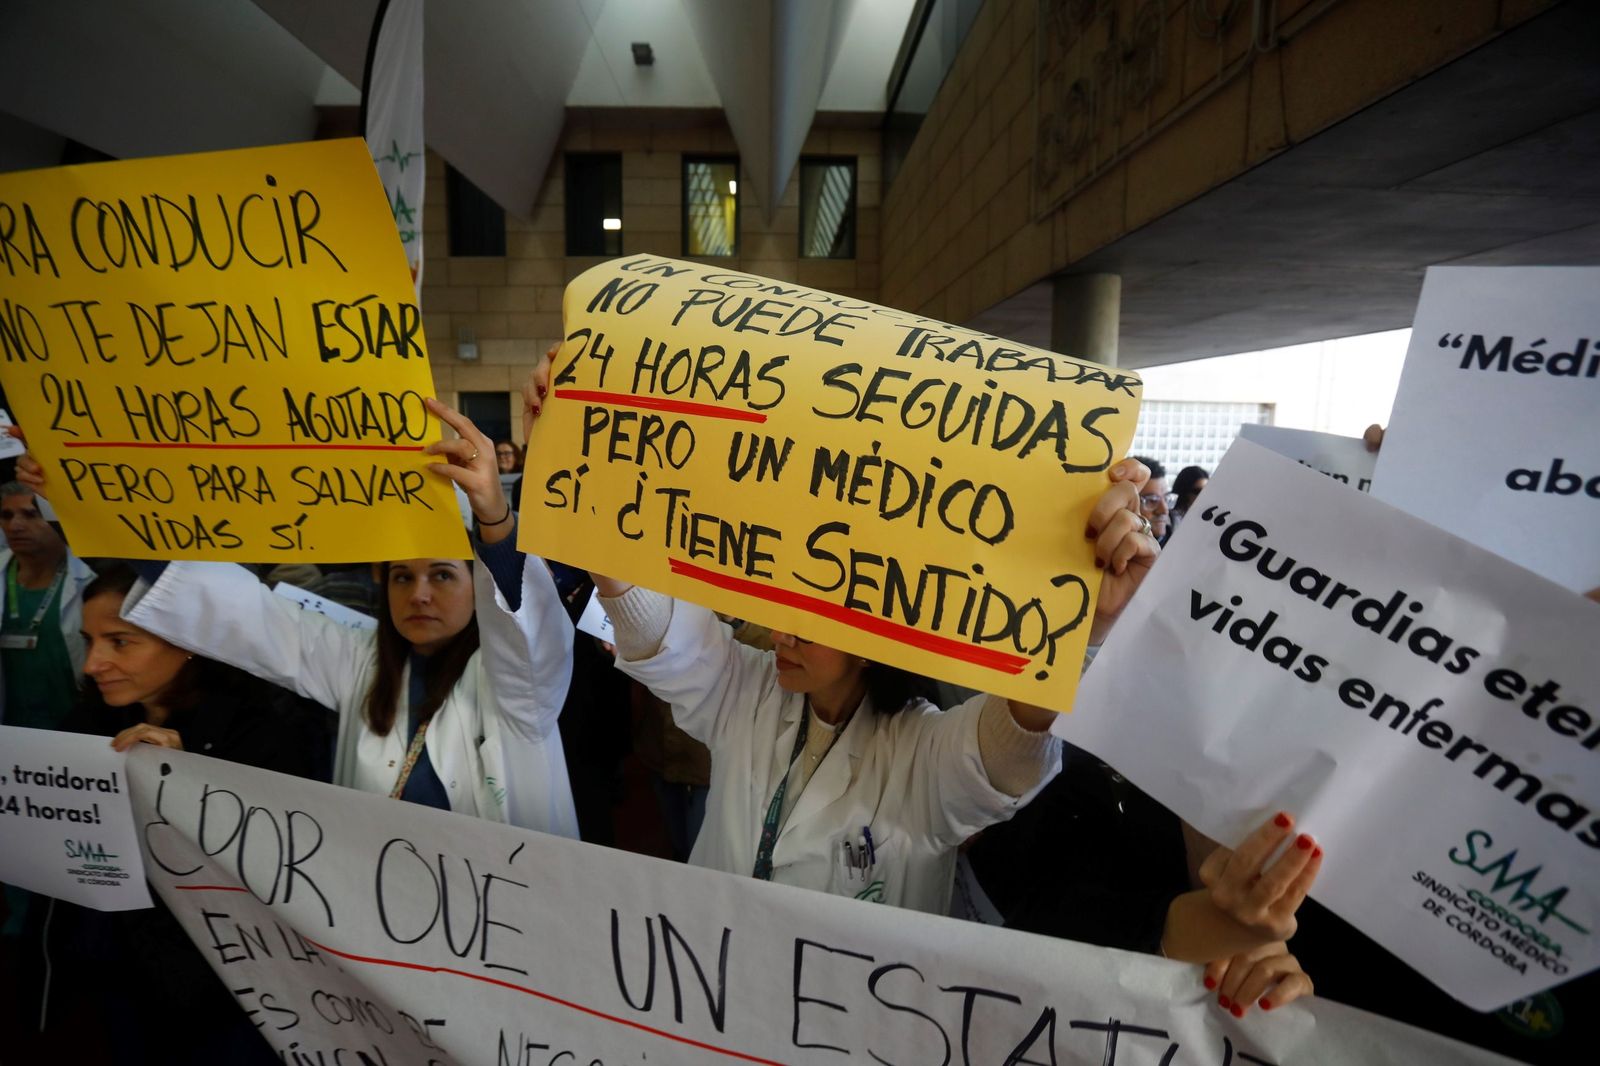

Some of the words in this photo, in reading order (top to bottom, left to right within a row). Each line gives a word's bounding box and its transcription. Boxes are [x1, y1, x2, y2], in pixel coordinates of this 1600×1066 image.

[0, 202, 60, 278] RA
[620, 258, 695, 278] UN
[0, 298, 49, 363] NO
[48, 301, 118, 364] TE
[128, 296, 289, 367] DEJAN
[312, 294, 424, 363] ESTAR
[586, 277, 660, 316] NO
[671, 288, 869, 346] PUEDE
[895, 324, 1144, 398] TRABAJAR
[554, 327, 615, 389] 24
[631, 337, 790, 410] HORAS
[40, 373, 103, 439] 24
[115, 385, 261, 443] HORAS
[282, 386, 428, 444] AGOTADO
[581, 406, 696, 470] PERO
[727, 430, 796, 483] UN
[60, 457, 175, 504] PERO
[187, 463, 276, 505] PARA
[290, 466, 434, 511] SALVAR
[1201, 505, 1481, 675] “Guardias
[1190, 588, 1330, 684] vidas
[13, 764, 119, 794] traidora!
[25, 796, 101, 825] horas!
[1412, 870, 1500, 932] SINDICATO
[1422, 897, 1446, 919] DE
[1448, 829, 1591, 936] SMA
[202, 907, 272, 965] EN
[611, 908, 732, 1034] UN
